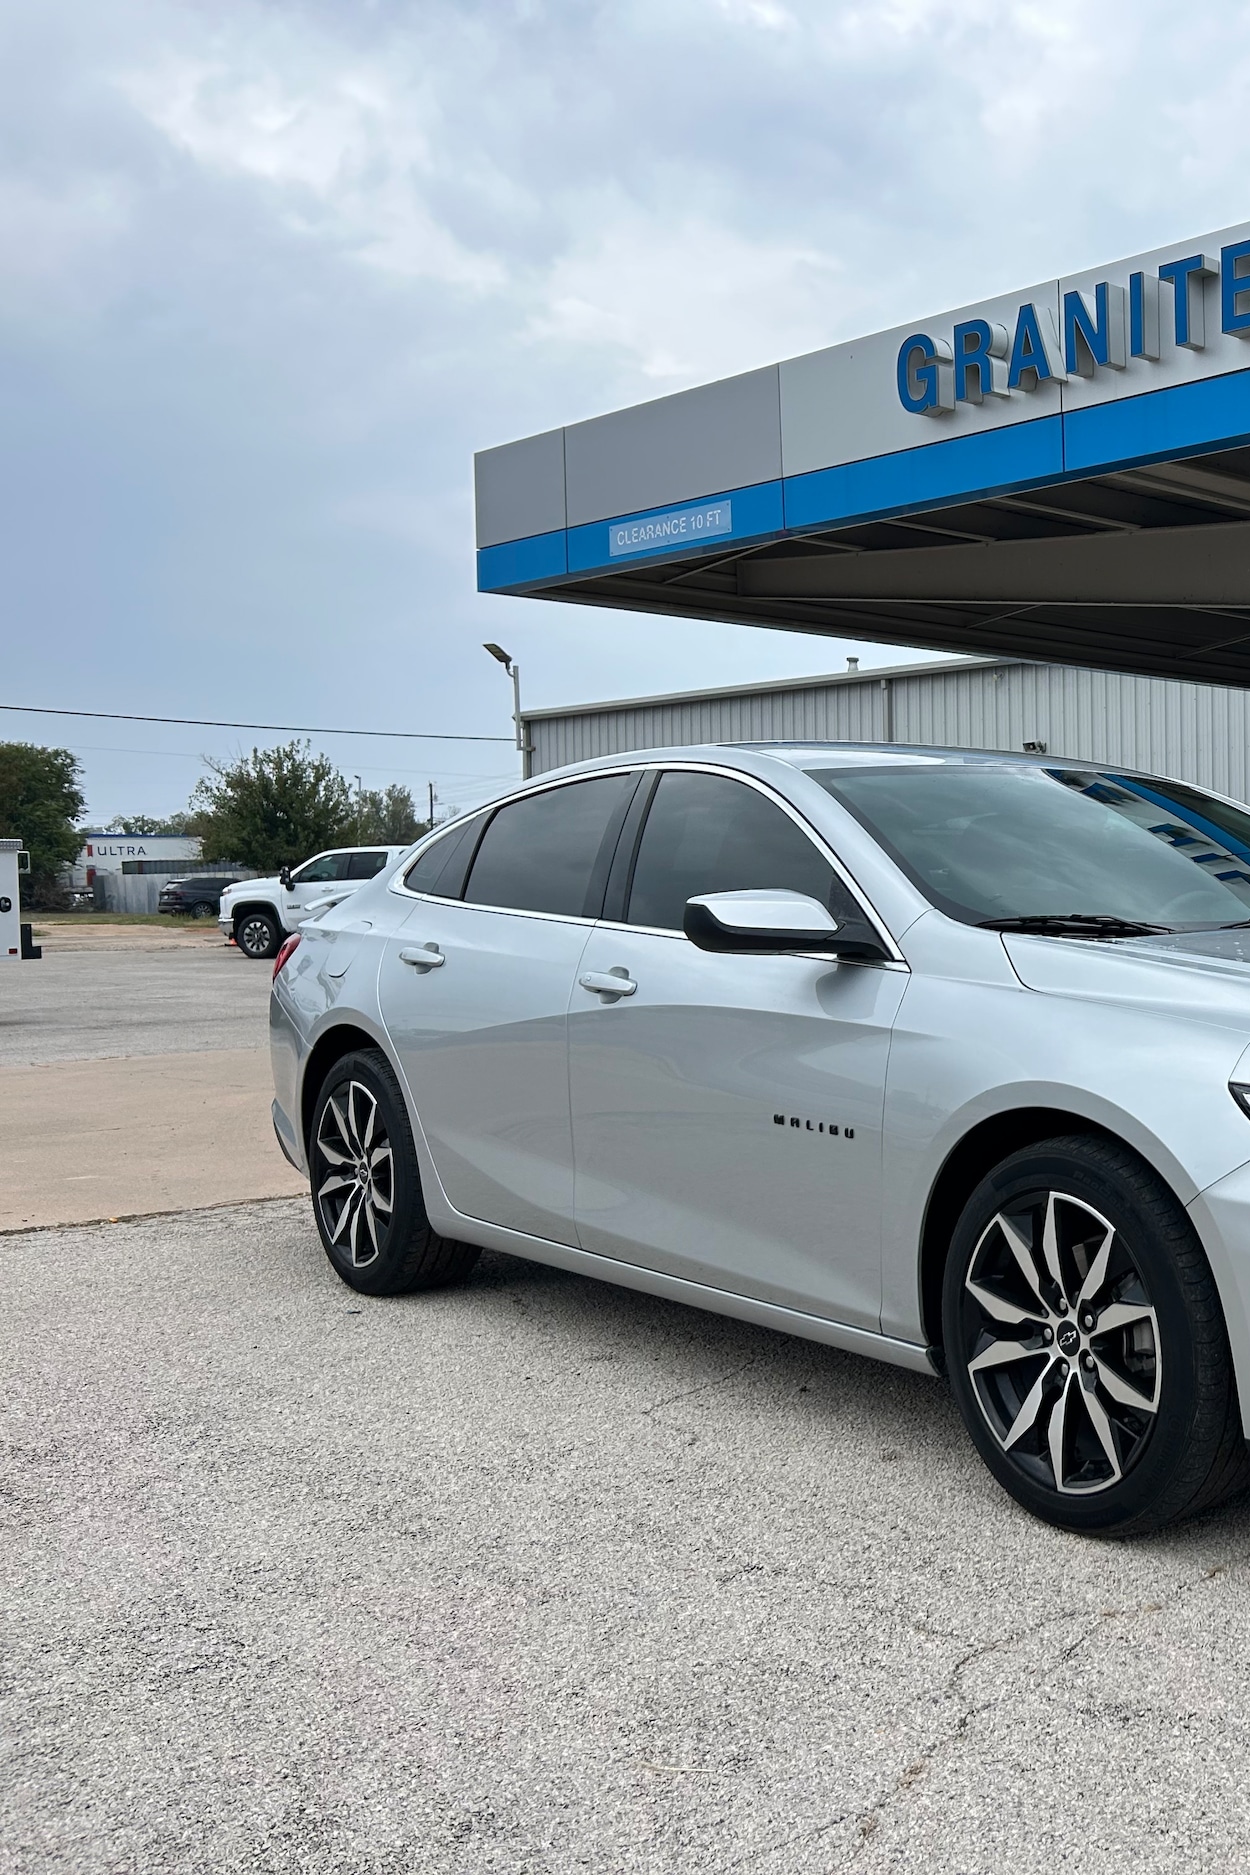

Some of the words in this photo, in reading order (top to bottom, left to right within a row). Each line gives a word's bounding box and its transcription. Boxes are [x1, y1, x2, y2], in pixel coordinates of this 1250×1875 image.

[617, 517, 686, 546] CLEARANCE
[691, 514, 704, 530] 10
[706, 509, 721, 528] FT
[97, 846, 147, 856] ULTRA
[773, 1114, 854, 1139] MALIBU
